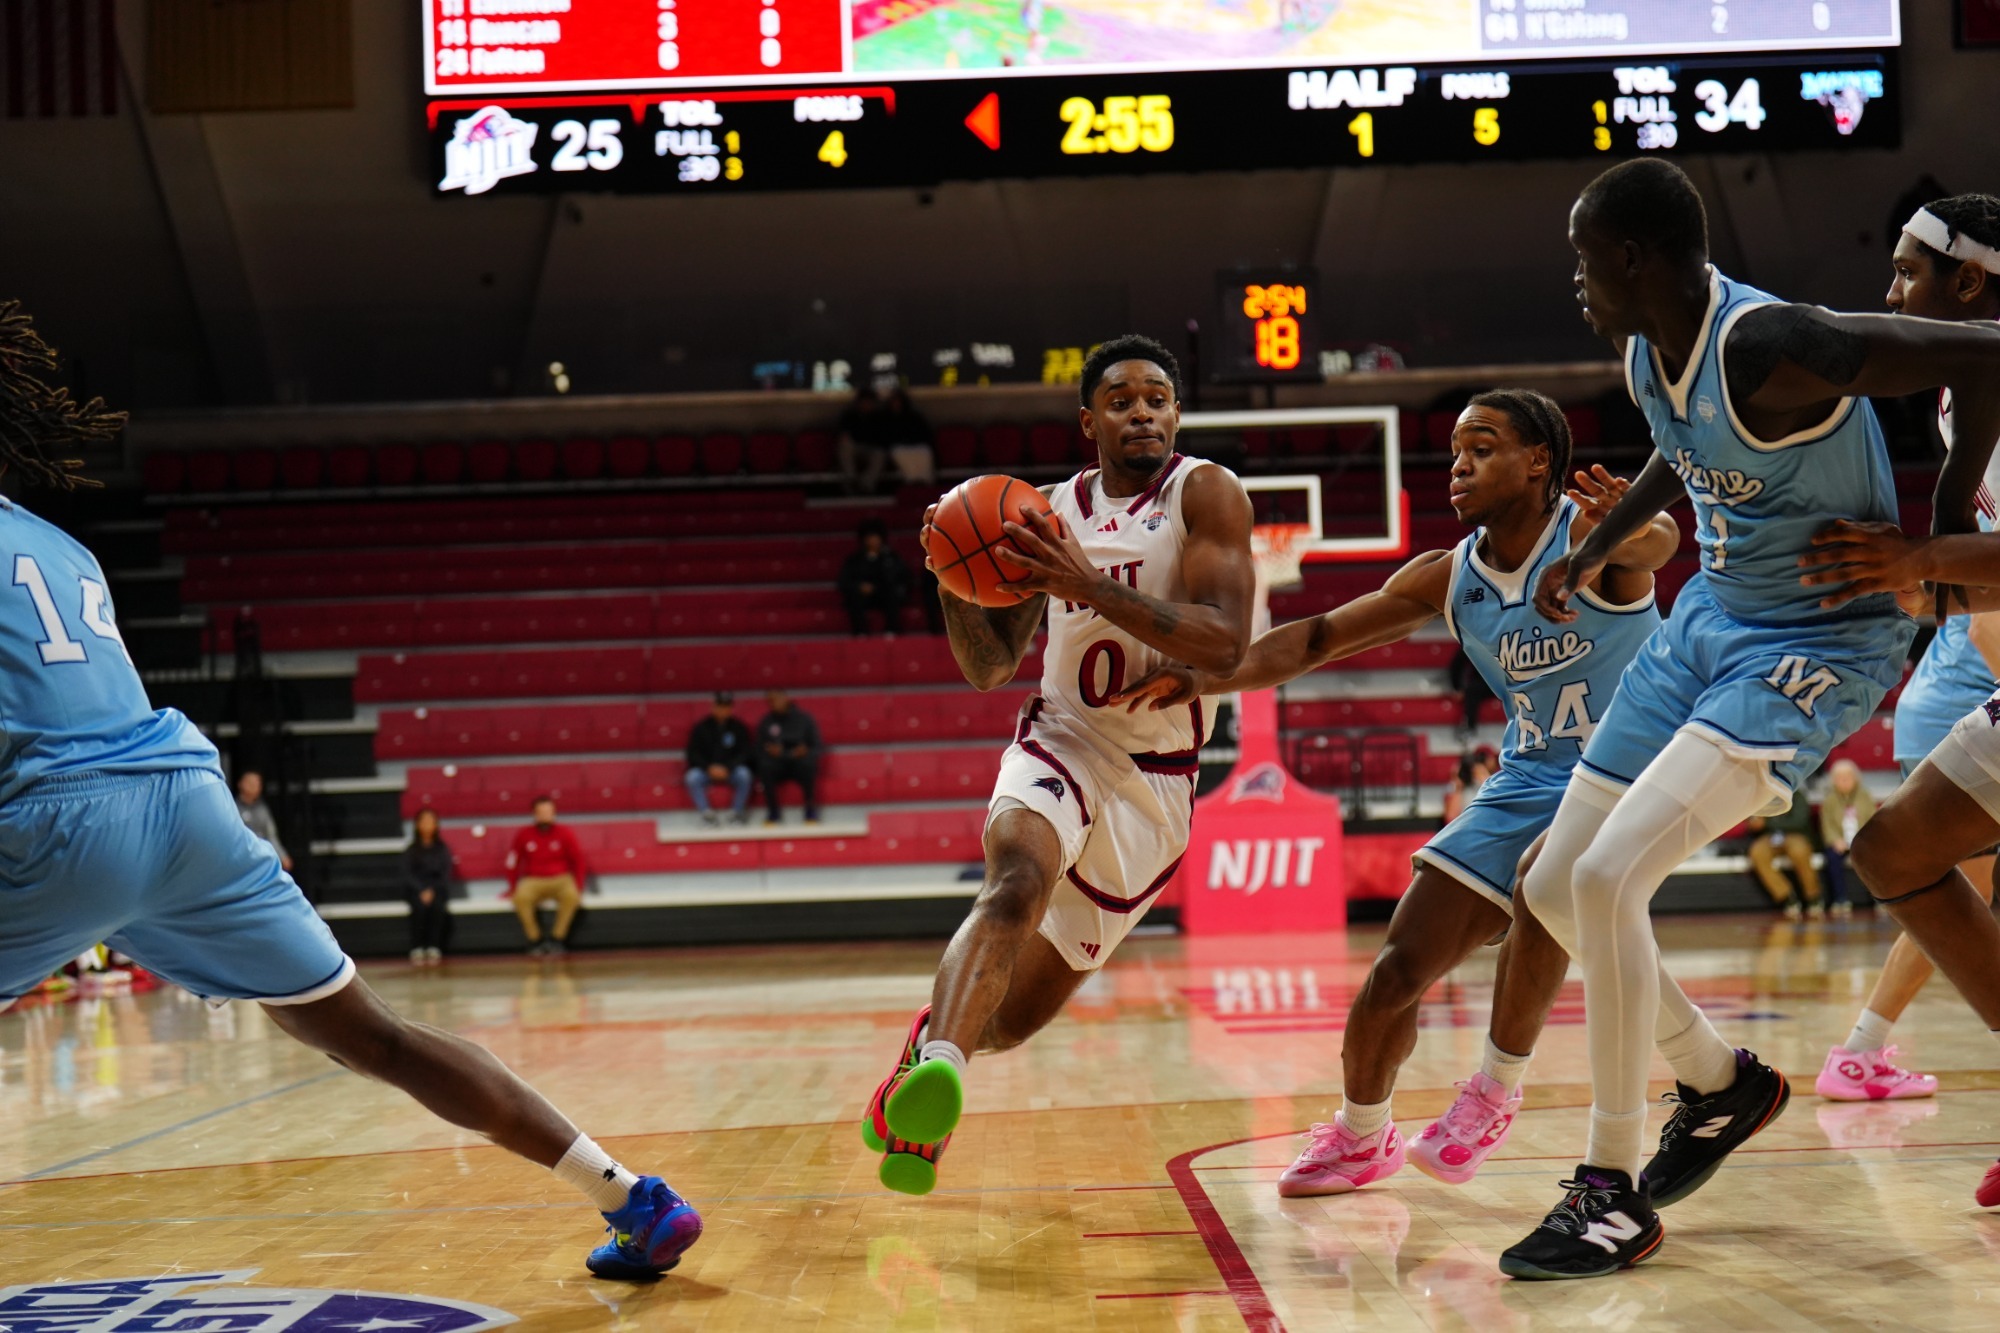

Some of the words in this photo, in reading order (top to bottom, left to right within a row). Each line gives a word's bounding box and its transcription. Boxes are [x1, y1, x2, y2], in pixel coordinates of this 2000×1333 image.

[1288, 67, 1417, 110] HALF
[1441, 72, 1511, 100] FOULS
[1613, 66, 1677, 95] TOL
[659, 99, 723, 127] TOL
[794, 95, 864, 122] FOULS
[1059, 94, 1175, 155] 2:55
[1473, 107, 1501, 145] 5
[1613, 96, 1678, 124] FULL
[1694, 77, 1767, 133] 34
[550, 119, 623, 171] 25
[655, 129, 721, 156] FULL
[724, 130, 741, 154] 1
[818, 130, 847, 167] 4
[1348, 111, 1374, 157] 1
[724, 156, 744, 181] 3
[1255, 314, 1300, 370] 18
[12, 553, 134, 667] 14
[1078, 638, 1126, 709] 0
[1494, 625, 1595, 682] Maine
[1761, 654, 1843, 720] M
[1509, 678, 1600, 756] 64
[1207, 837, 1325, 896] NJIT
